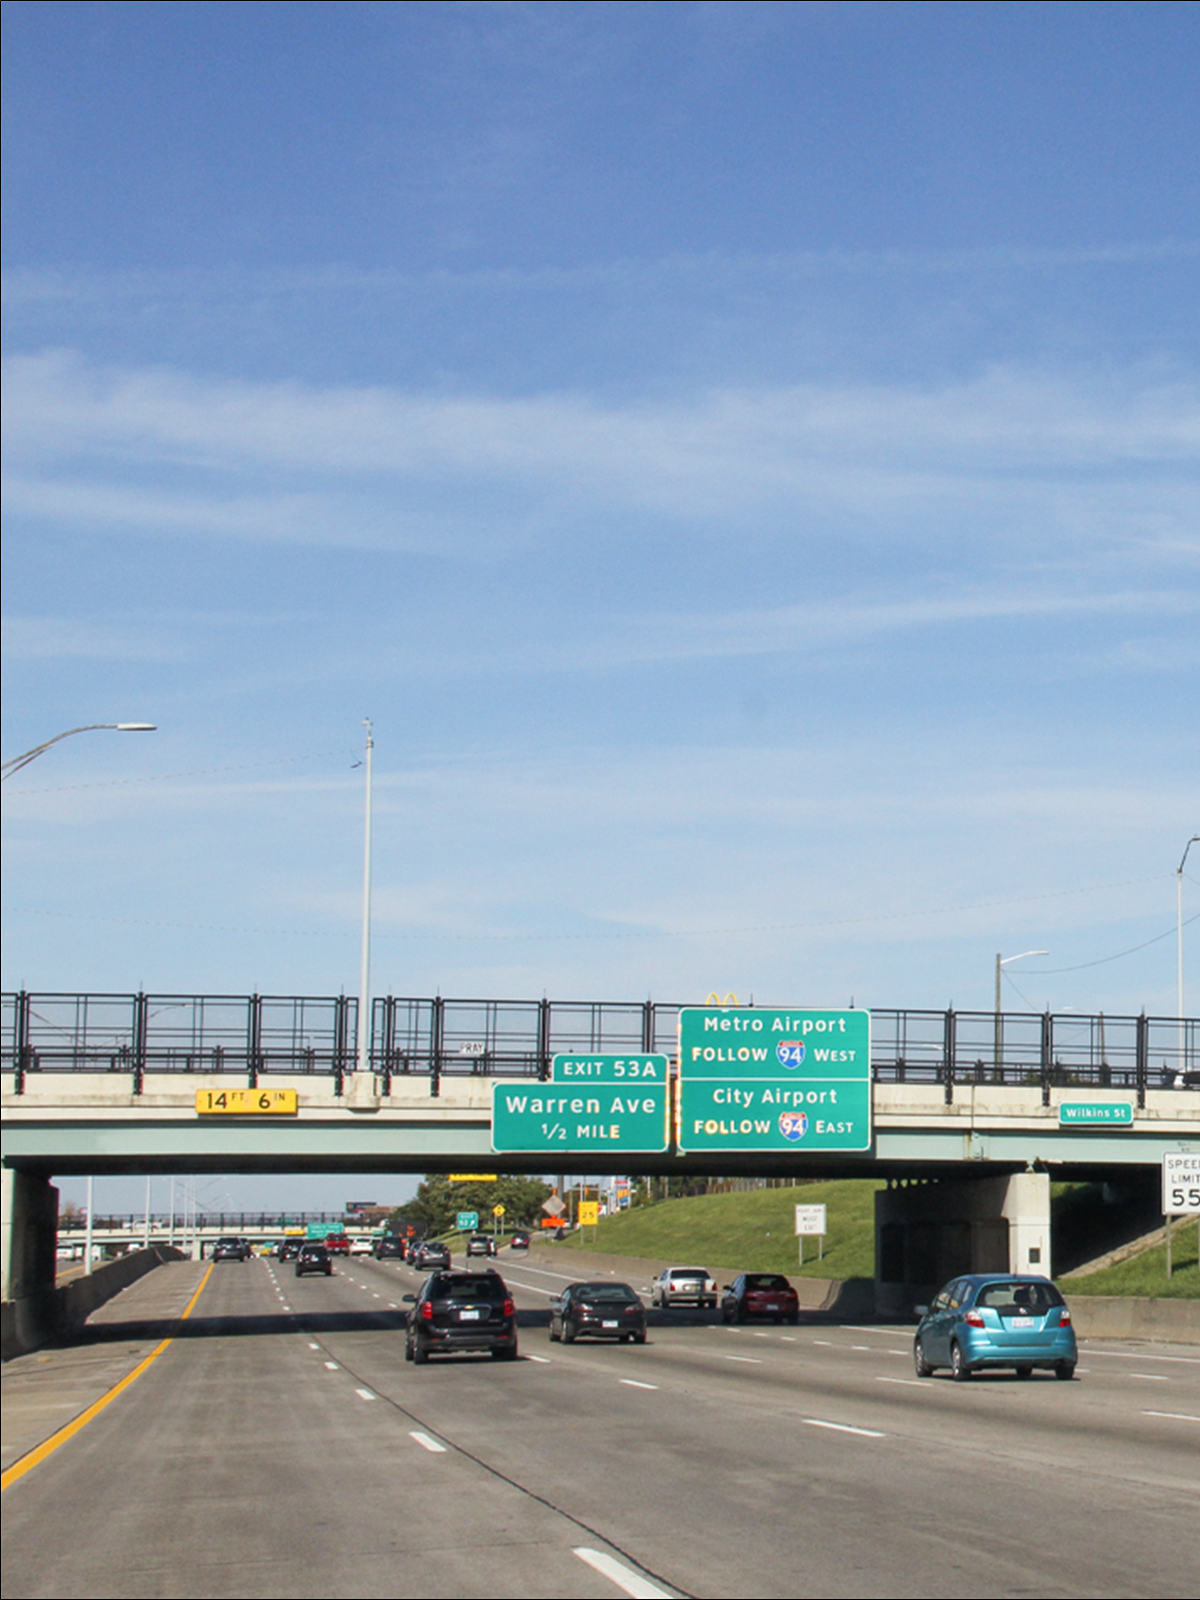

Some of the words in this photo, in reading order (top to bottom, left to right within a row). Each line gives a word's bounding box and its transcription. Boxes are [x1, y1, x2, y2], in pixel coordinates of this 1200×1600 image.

[704, 1016, 763, 1032] Metro
[771, 1016, 846, 1035] Airport
[692, 1047, 768, 1062] FOLLOW
[779, 1047, 802, 1063] 94
[814, 1049, 856, 1062] WEST
[563, 1062, 604, 1075] EXIT
[614, 1060, 657, 1077] 53A
[207, 1092, 227, 1109] 14
[231, 1092, 245, 1101] FT
[258, 1093, 271, 1109] 6
[273, 1093, 286, 1101] IN
[506, 1096, 600, 1114] Warren
[610, 1097, 656, 1114] Ave
[713, 1088, 754, 1108] City
[761, 1088, 837, 1107] Airport
[1066, 1107, 1110, 1118] Wilkins
[1114, 1108, 1126, 1118] St
[577, 1125, 620, 1139] MILE
[694, 1119, 770, 1134] FOLLOW
[780, 1119, 804, 1135] 94
[816, 1120, 853, 1134] EAST
[1171, 1174, 1200, 1184] LIMIT
[582, 1211, 595, 1220] 25
